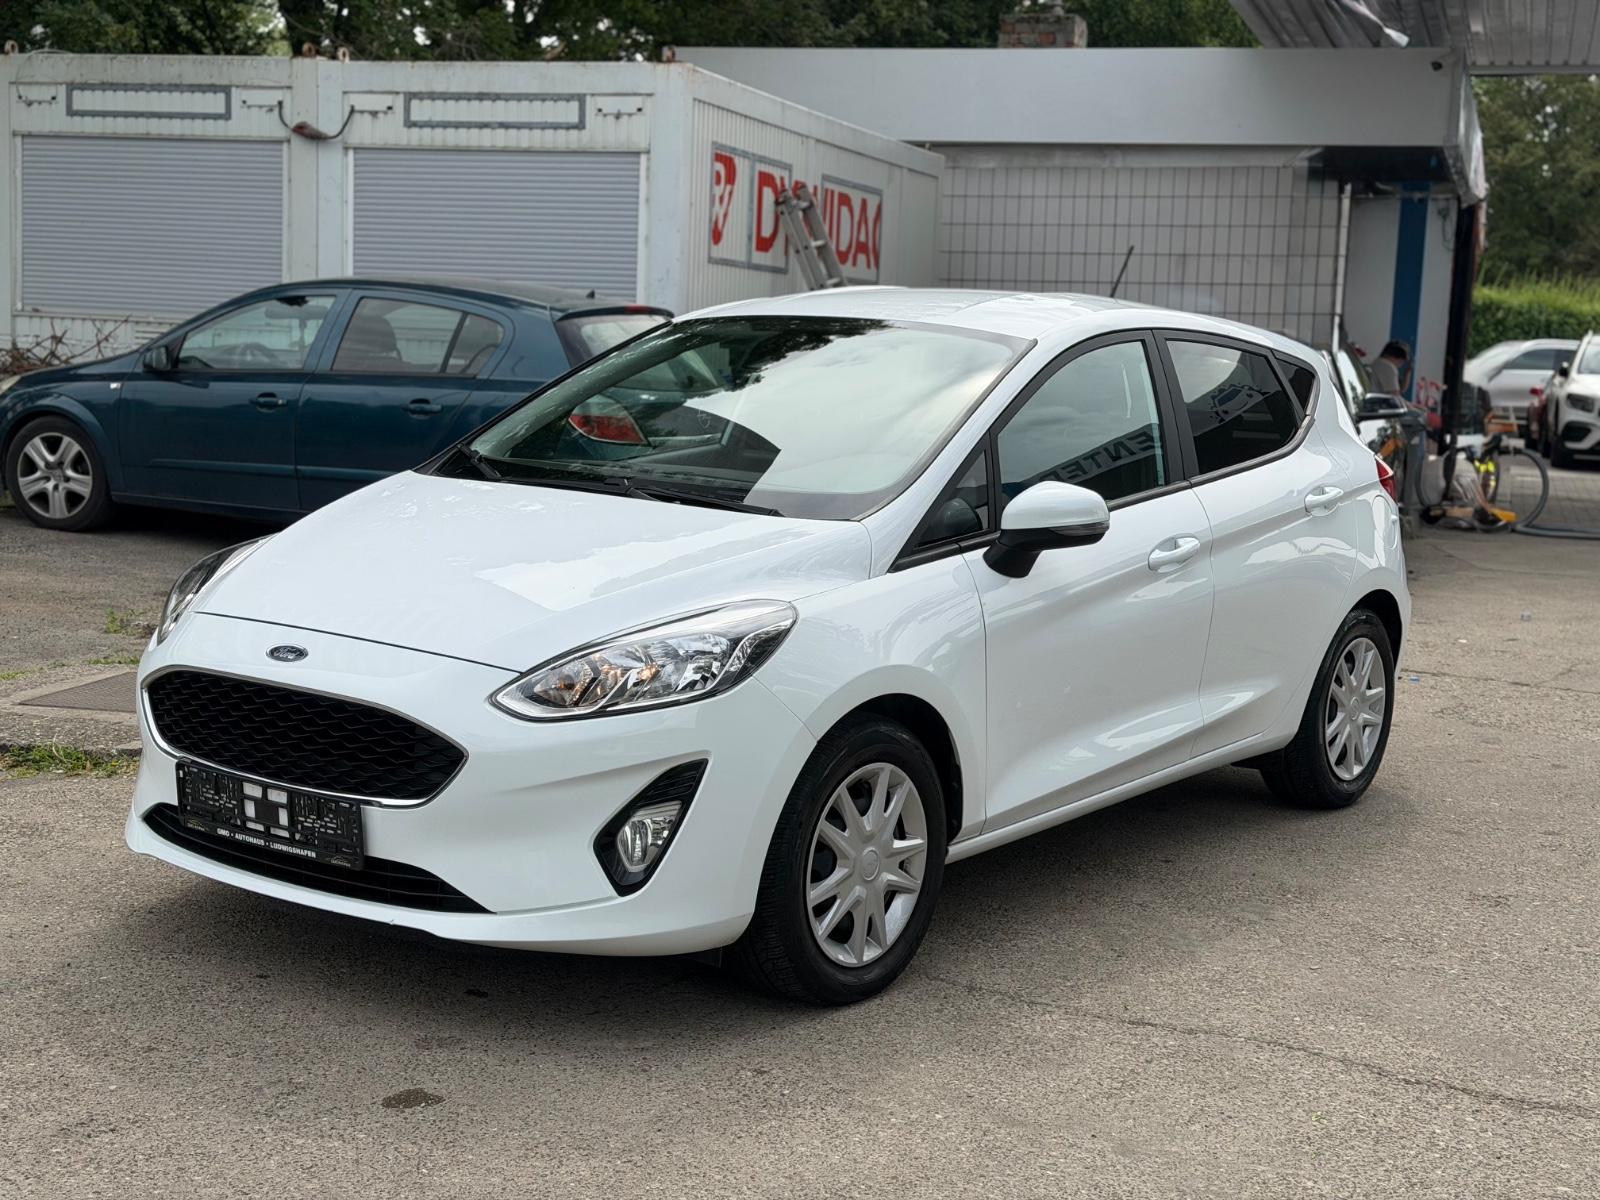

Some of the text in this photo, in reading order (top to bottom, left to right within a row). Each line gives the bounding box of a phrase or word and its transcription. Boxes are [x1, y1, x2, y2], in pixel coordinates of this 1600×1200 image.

[271, 646, 303, 660] Ford
[234, 833, 265, 846] AUTOHAUS
[269, 842, 317, 858] LUDWIGSHAFEN
